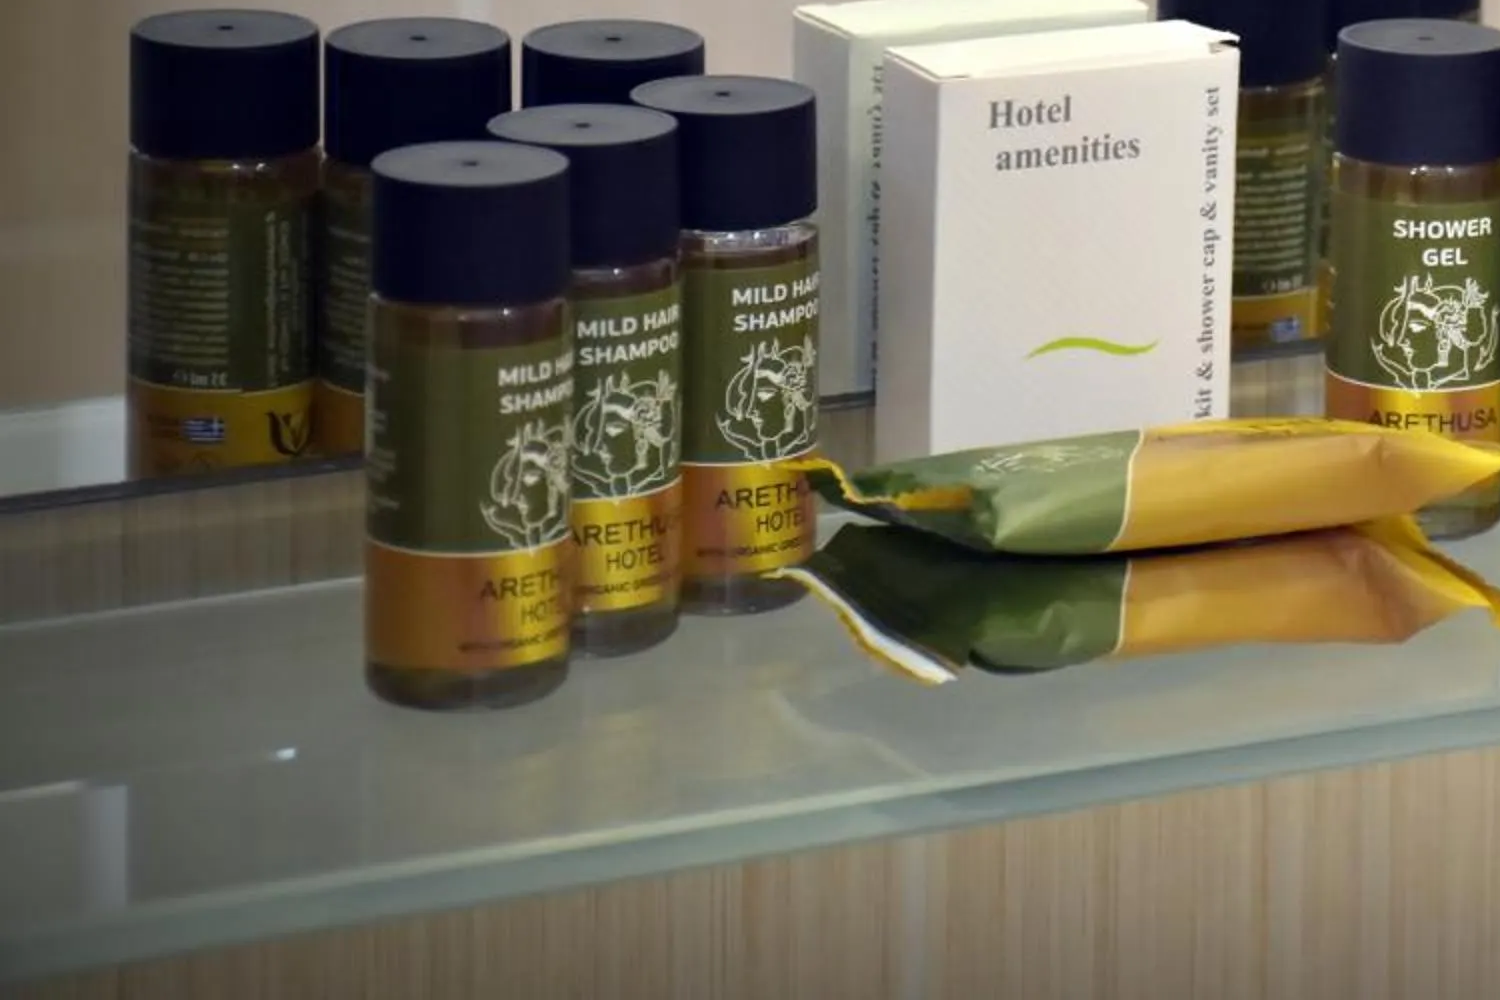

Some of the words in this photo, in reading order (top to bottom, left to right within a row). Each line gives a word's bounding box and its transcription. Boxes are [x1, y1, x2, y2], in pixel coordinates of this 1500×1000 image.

[988, 94, 1072, 129] Hotel
[1206, 86, 1220, 117] set
[995, 133, 1142, 172] amenities
[1202, 125, 1224, 193] vanity
[1200, 201, 1217, 221] &
[1392, 216, 1493, 240] SHOWER
[1202, 229, 1221, 267] cap
[1422, 247, 1468, 267] GEL
[732, 284, 788, 307] MILD
[577, 316, 638, 339] MILD
[1197, 275, 1215, 354] shower
[579, 331, 680, 367] SHAMPOO
[498, 360, 551, 387] MILD
[1196, 360, 1213, 381] &
[500, 378, 575, 415] SHAMP
[1194, 388, 1213, 419] kit
[715, 482, 800, 509] ARETH
[756, 508, 805, 533] HOTE
[480, 567, 562, 601] ARETH
